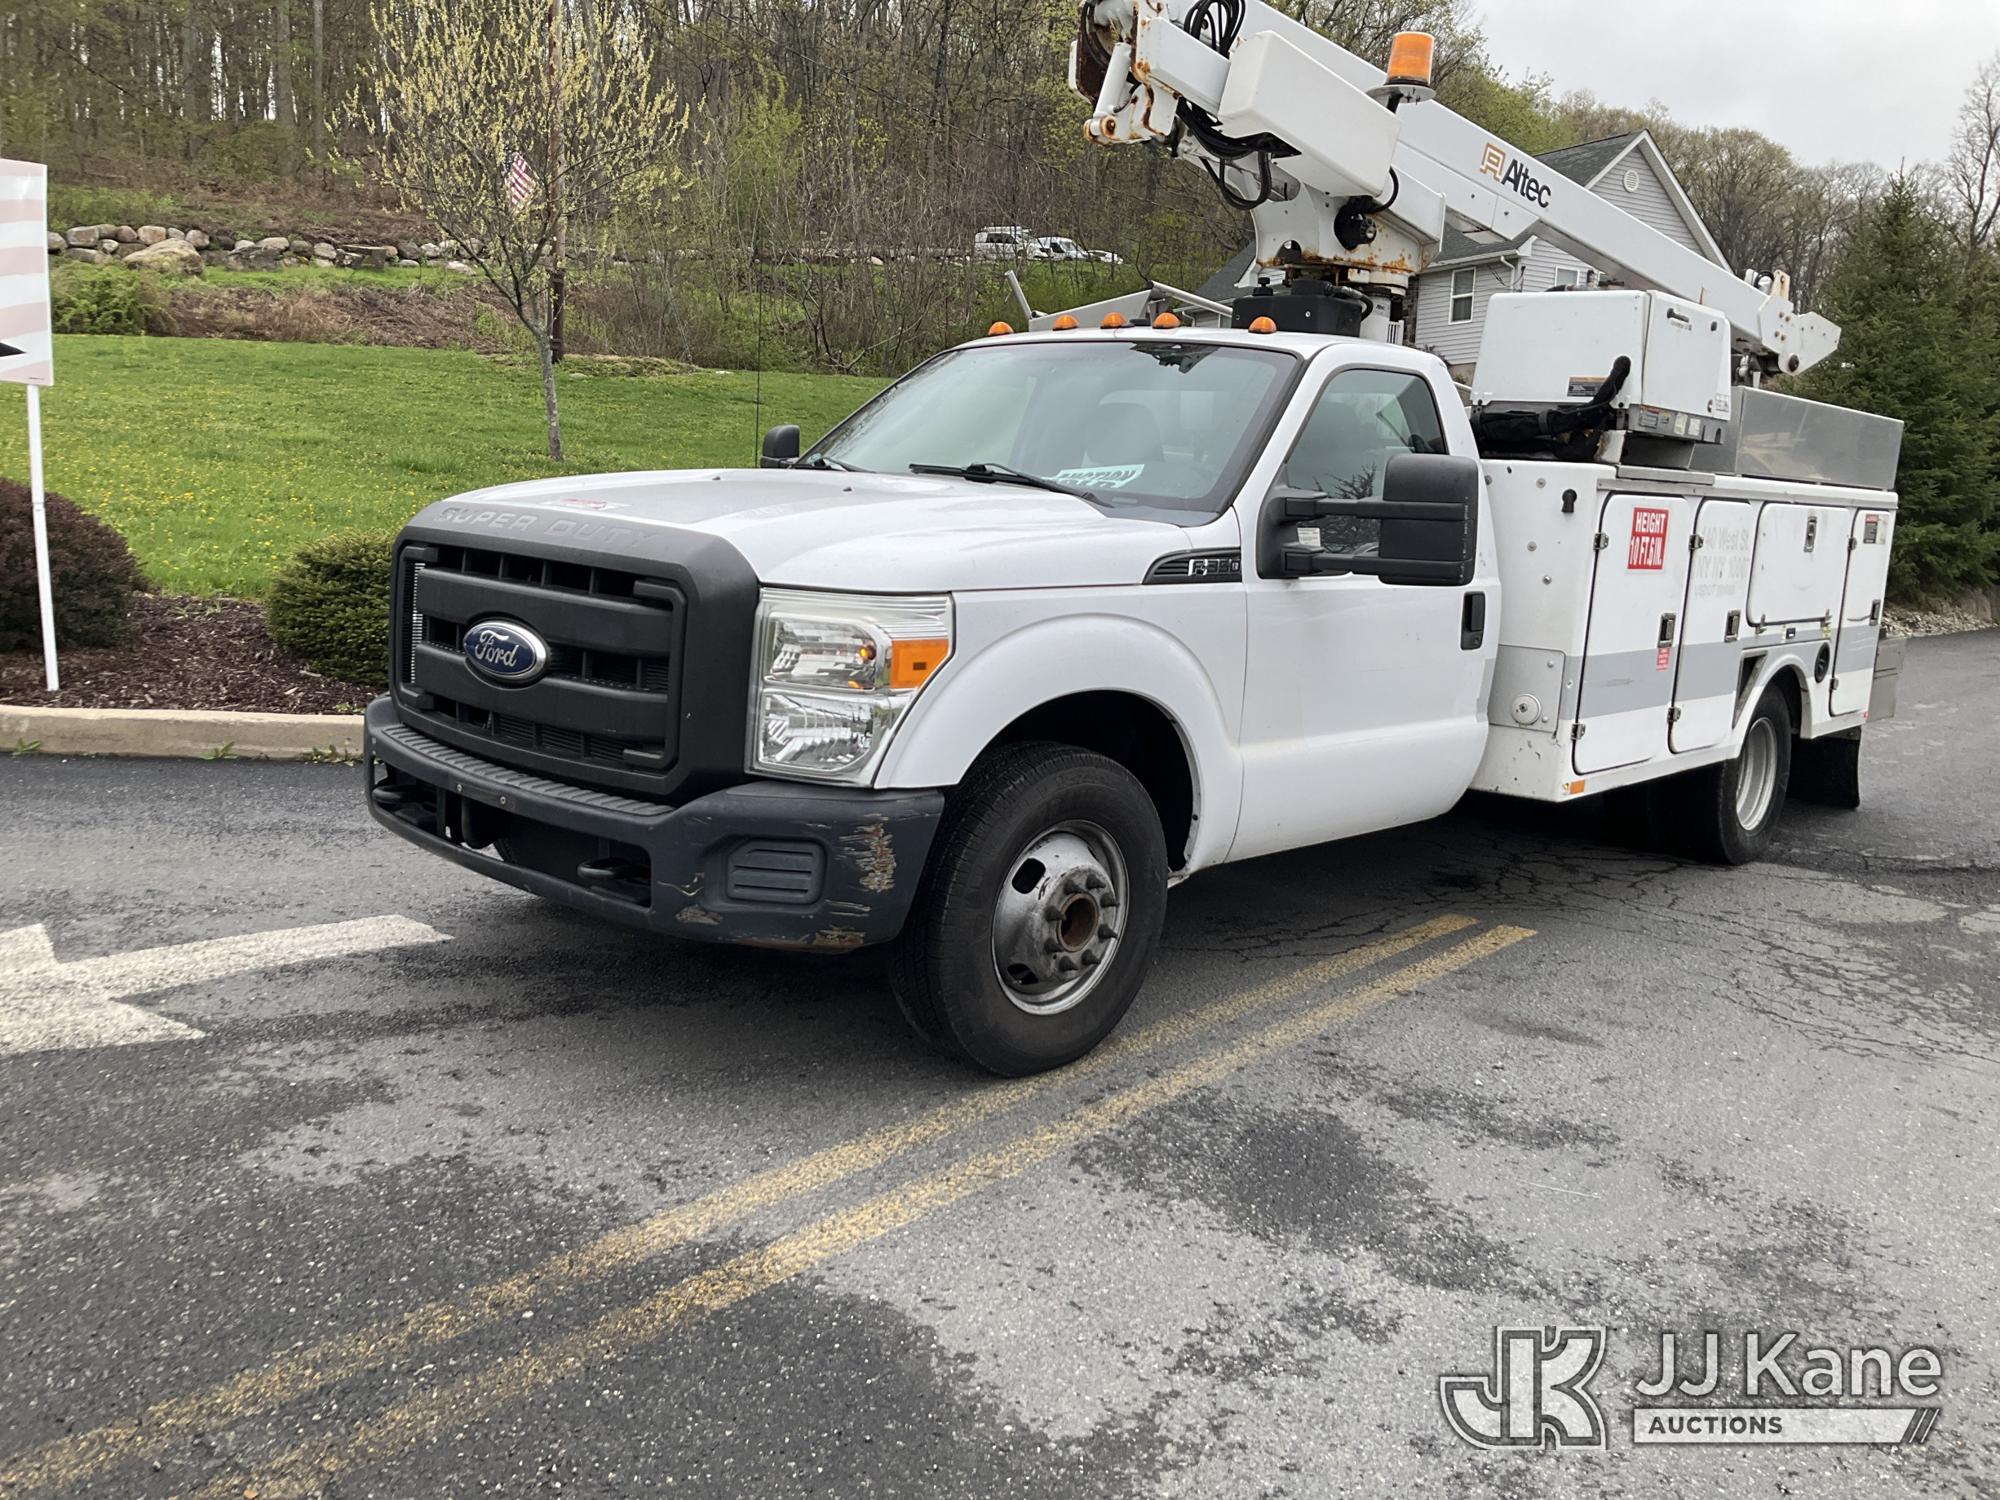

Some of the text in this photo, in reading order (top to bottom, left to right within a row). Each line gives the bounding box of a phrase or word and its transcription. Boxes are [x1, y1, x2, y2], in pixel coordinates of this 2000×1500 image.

[1501, 158, 1551, 208] Altec
[435, 506, 659, 548] SUPER DUTY
[1634, 511, 1666, 534] HEIGHT
[475, 630, 519, 667] Ford
